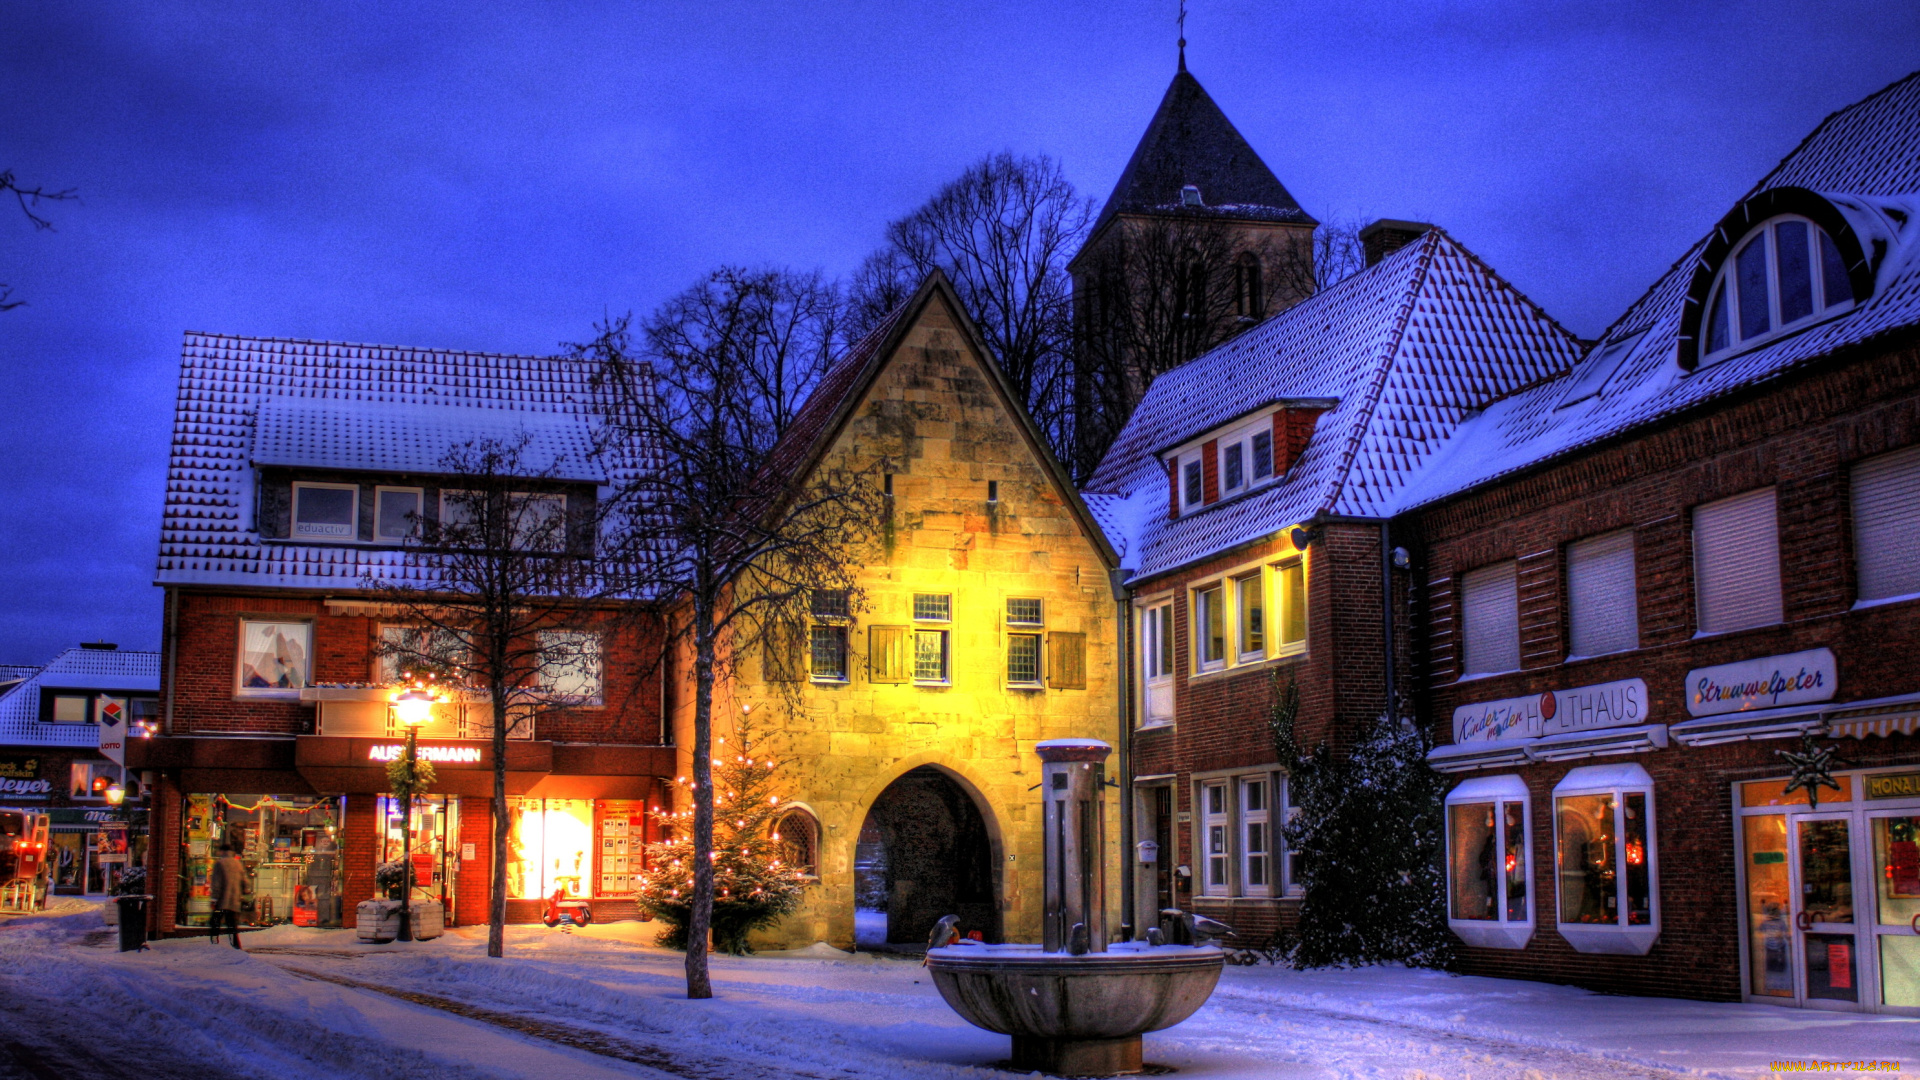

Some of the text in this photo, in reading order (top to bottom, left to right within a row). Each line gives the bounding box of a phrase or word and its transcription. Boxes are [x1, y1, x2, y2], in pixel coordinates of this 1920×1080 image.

[298, 524, 344, 534] eduactiv
[1697, 667, 1824, 704] Struwwelpeter
[101, 742, 121, 750] LOTTO
[369, 745, 481, 762] AUSERMANN
[1871, 777, 1912, 795] MONA
